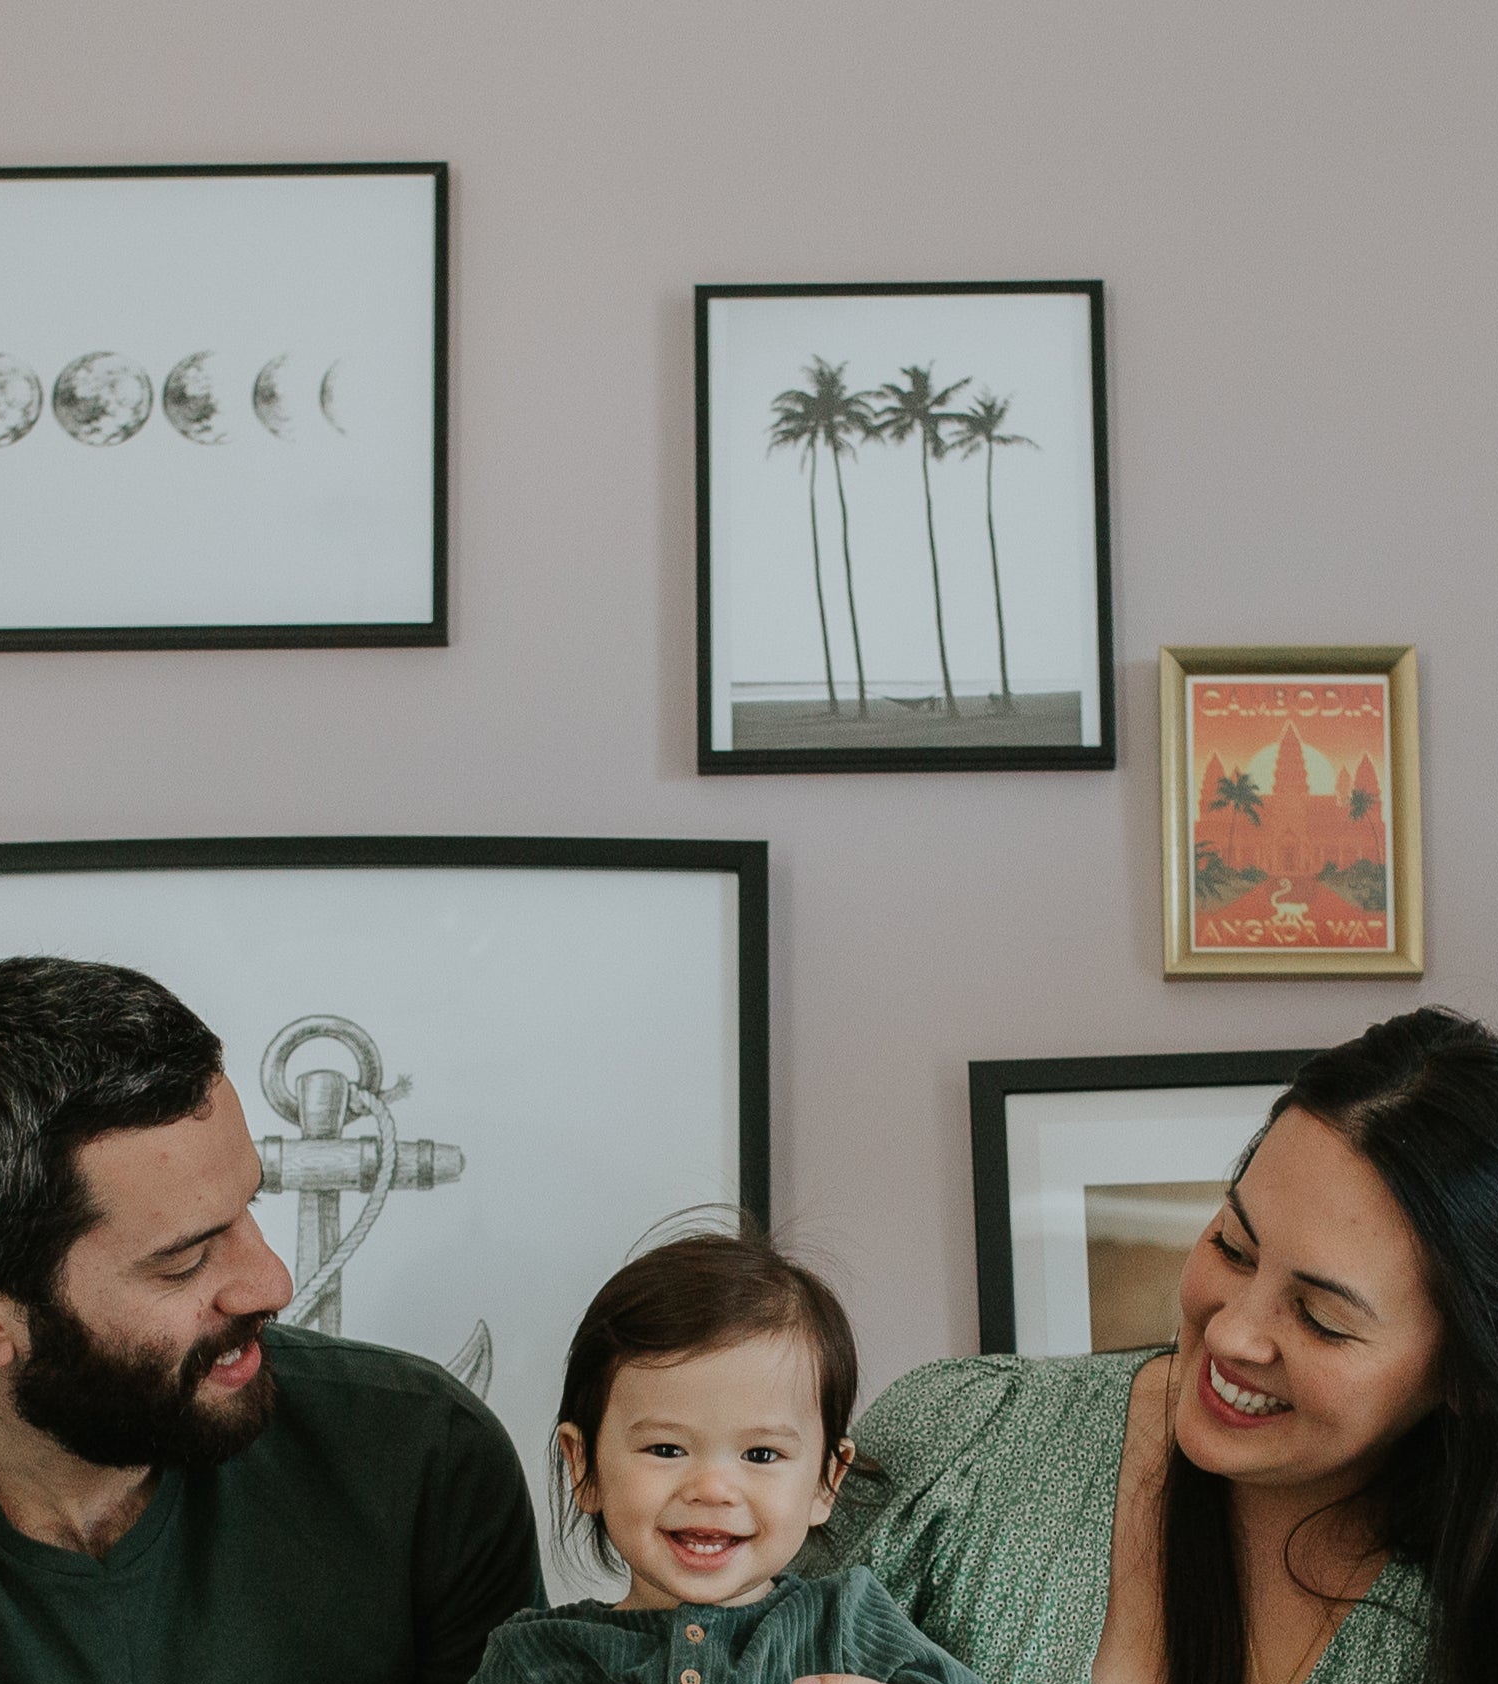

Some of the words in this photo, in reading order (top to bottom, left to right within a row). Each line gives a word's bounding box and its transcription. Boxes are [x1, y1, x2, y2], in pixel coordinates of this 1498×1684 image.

[1198, 686, 1382, 718] CAMBODIA
[1200, 920, 1319, 944] ANGKOR
[1326, 919, 1383, 944] WAT
